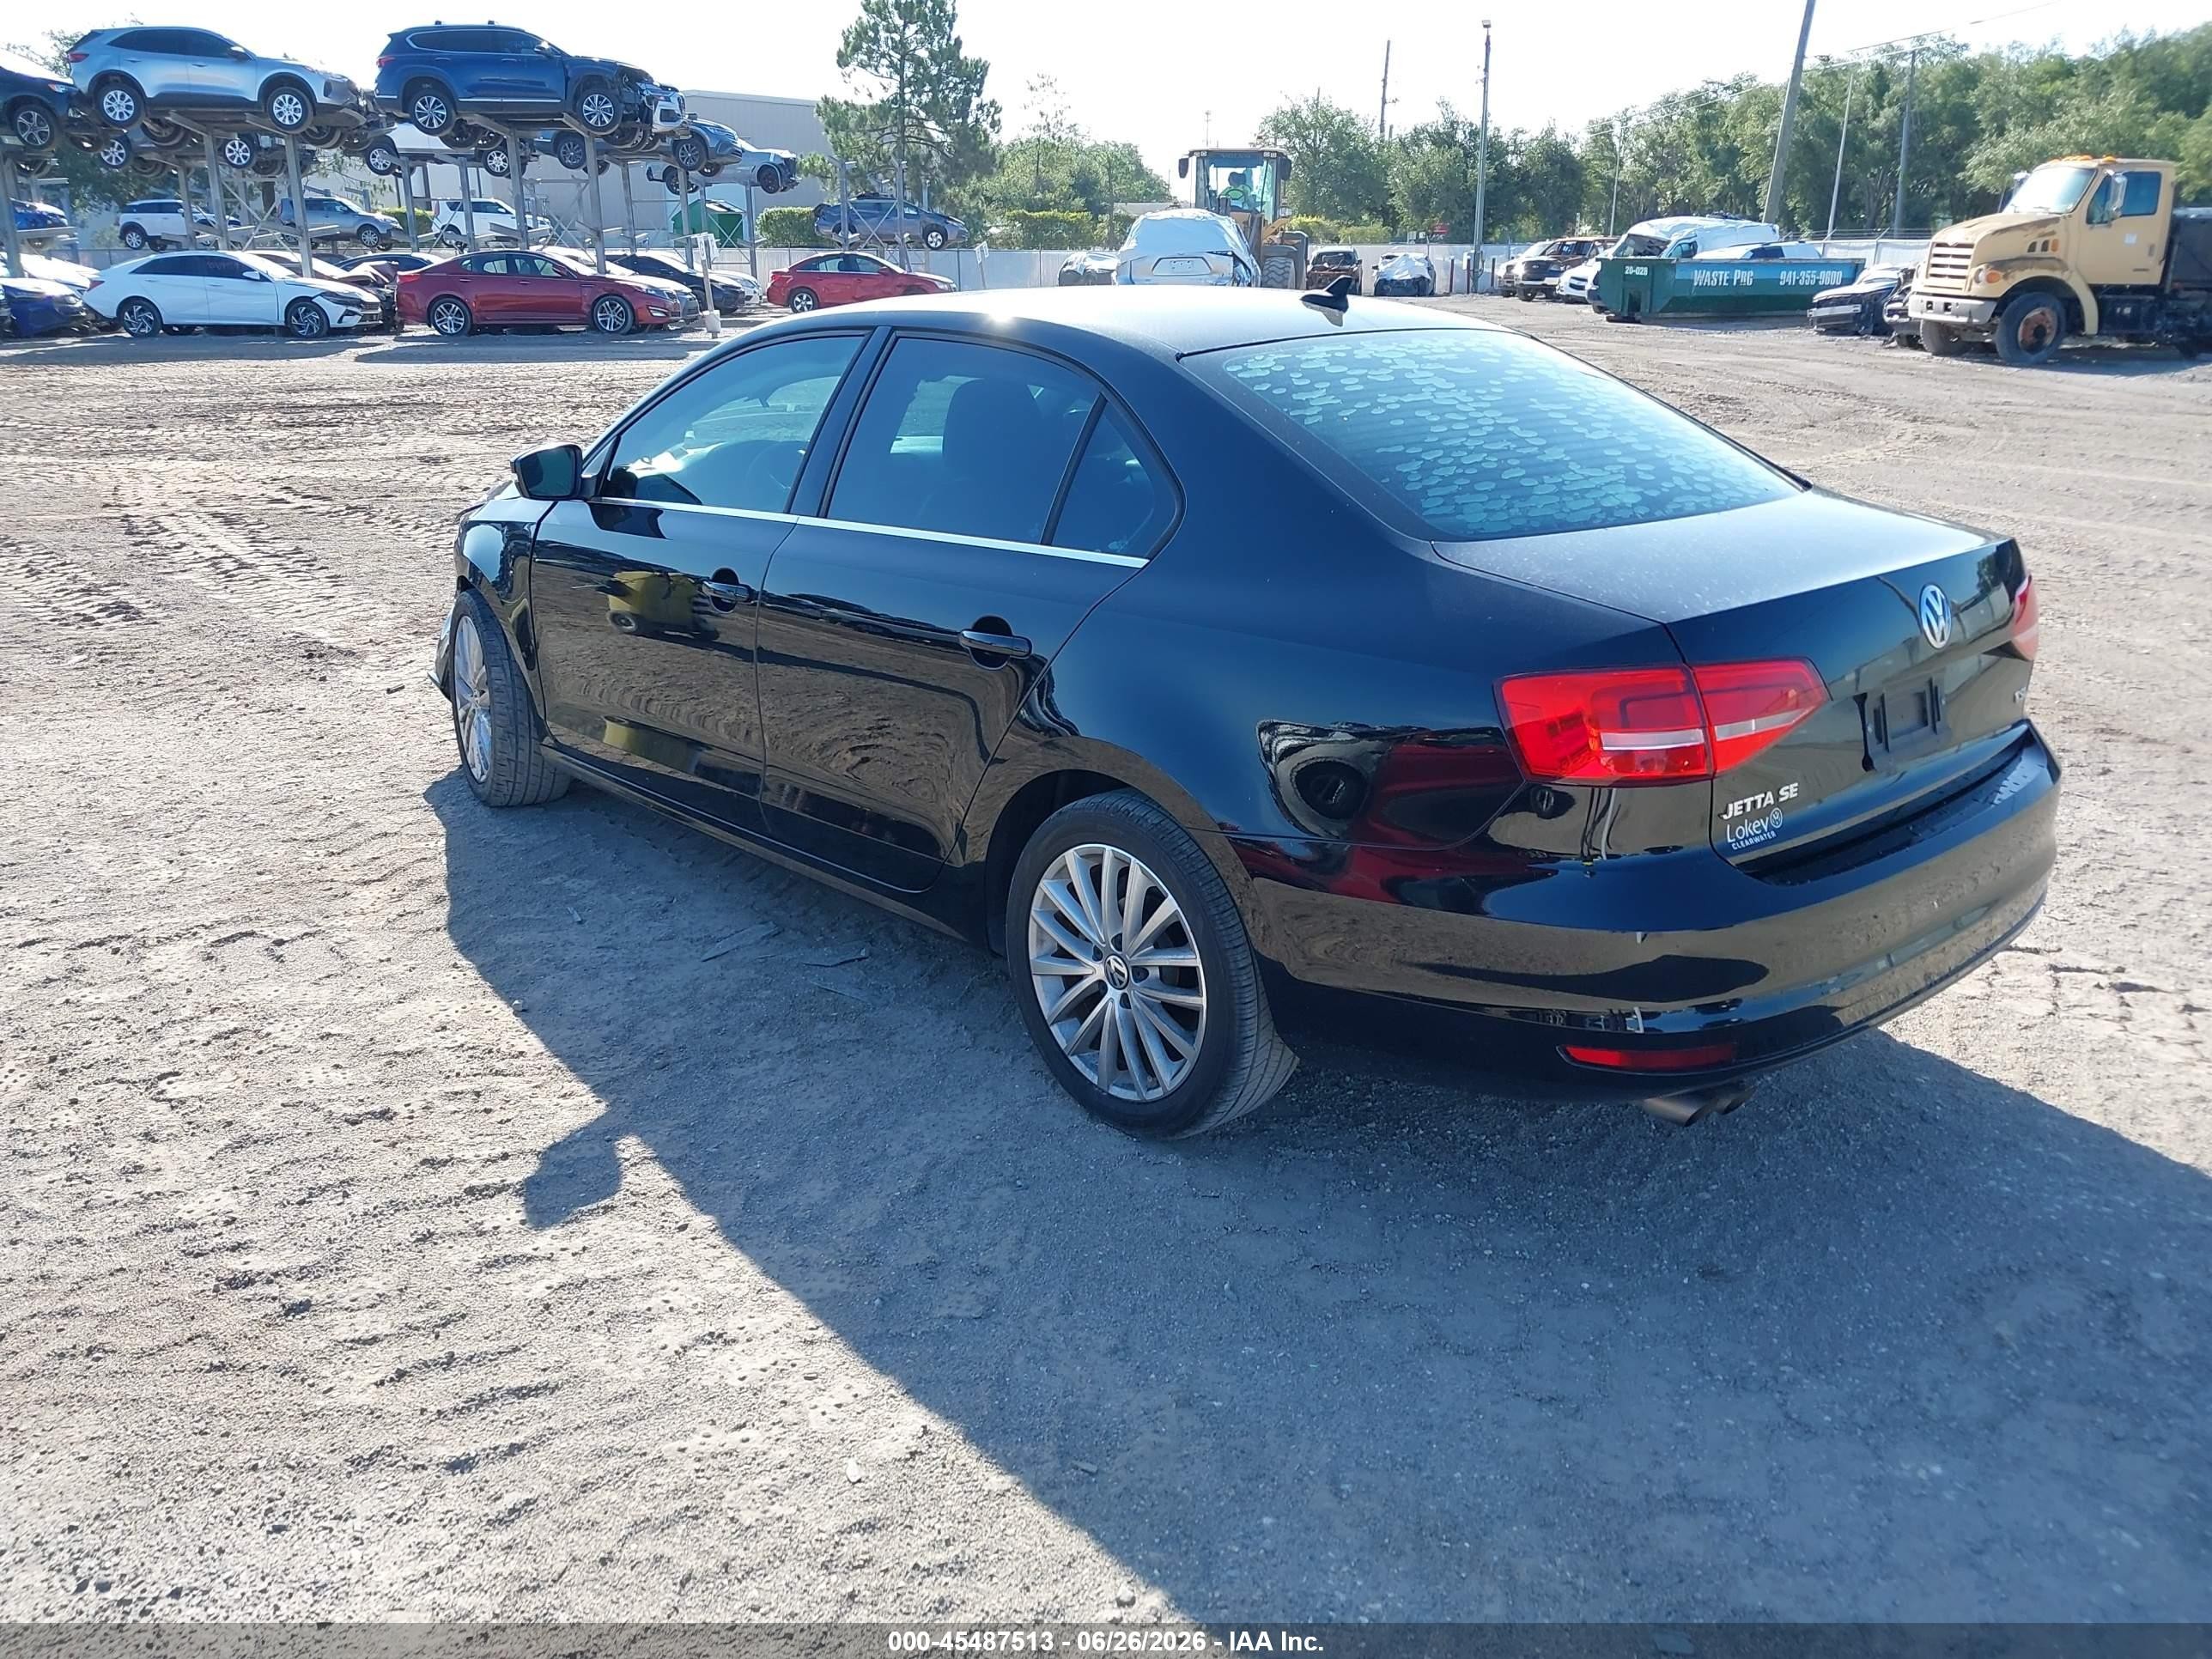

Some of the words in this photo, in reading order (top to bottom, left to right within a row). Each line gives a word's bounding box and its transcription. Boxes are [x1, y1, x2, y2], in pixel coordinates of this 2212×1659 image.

[1693, 270, 1730, 286] WASTE
[1722, 792, 1774, 820] JETTA
[1779, 782, 1800, 803] SE
[1732, 830, 1776, 850] CLEARWATER
